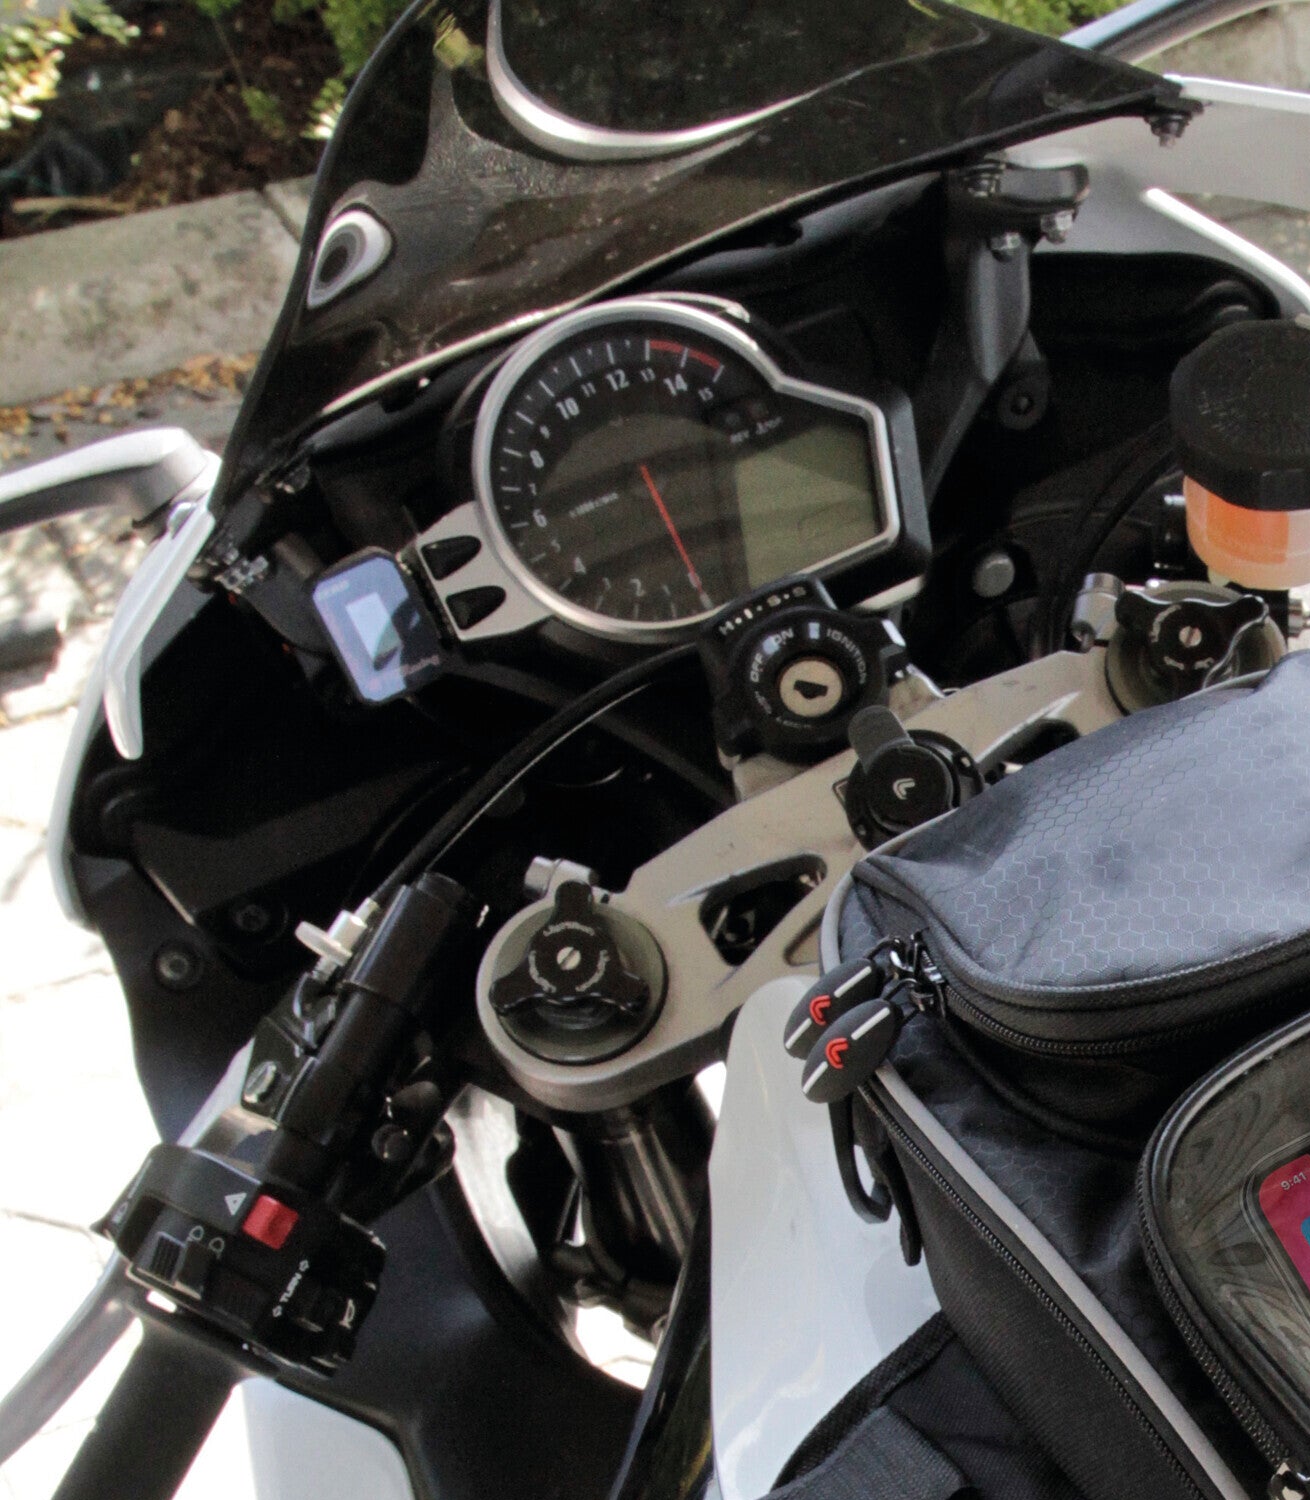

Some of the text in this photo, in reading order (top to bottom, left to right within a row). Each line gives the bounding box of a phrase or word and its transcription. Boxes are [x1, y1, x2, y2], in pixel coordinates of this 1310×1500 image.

[581, 382, 596, 397] 11
[606, 369, 629, 391] 12
[663, 373, 688, 396] 14
[698, 388, 713, 401] 15
[556, 397, 580, 420] 10
[539, 425, 550, 438] 9
[530, 450, 544, 468] 8
[529, 483, 537, 495] 7
[533, 509, 547, 528] 6
[574, 557, 586, 574] 4
[630, 578, 645, 597] 2
[772, 627, 795, 645] ON
[825, 627, 867, 685] IGNITION
[750, 652, 765, 684] OFF
[1280, 1171, 1307, 1191] 9:41
